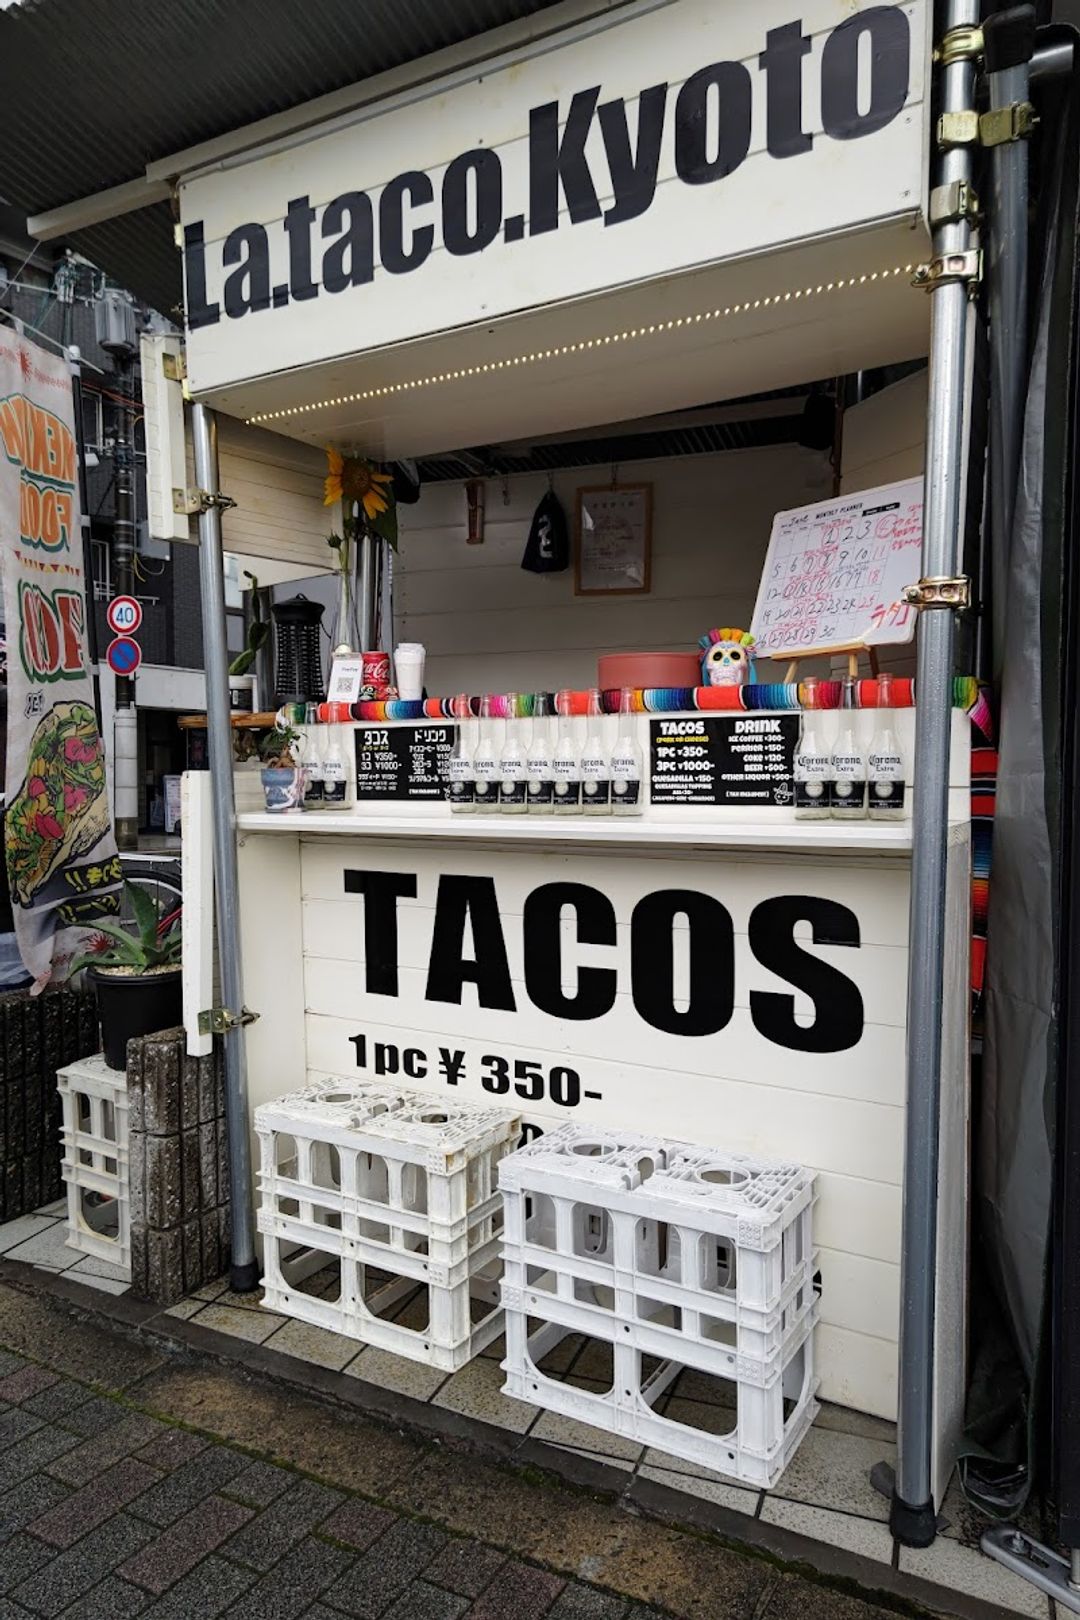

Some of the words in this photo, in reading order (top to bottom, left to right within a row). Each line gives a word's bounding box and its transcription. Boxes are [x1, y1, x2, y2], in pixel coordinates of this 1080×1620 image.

[184, 6, 910, 329] La.taco.Kyoto
[116, 607, 134, 624] 40
[660, 721, 705, 735] TACOS
[734, 719, 782, 734] DRINK
[364, 730, 389, 746] タコス
[414, 729, 447, 743] ドリンク
[656, 746, 676, 758] 1PC
[656, 760, 676, 772] 3PC
[344, 869, 865, 1053] TACOS
[348, 1034, 427, 1079] 1pc
[439, 1047, 466, 1085] ¥
[481, 1055, 603, 1107] 350-
